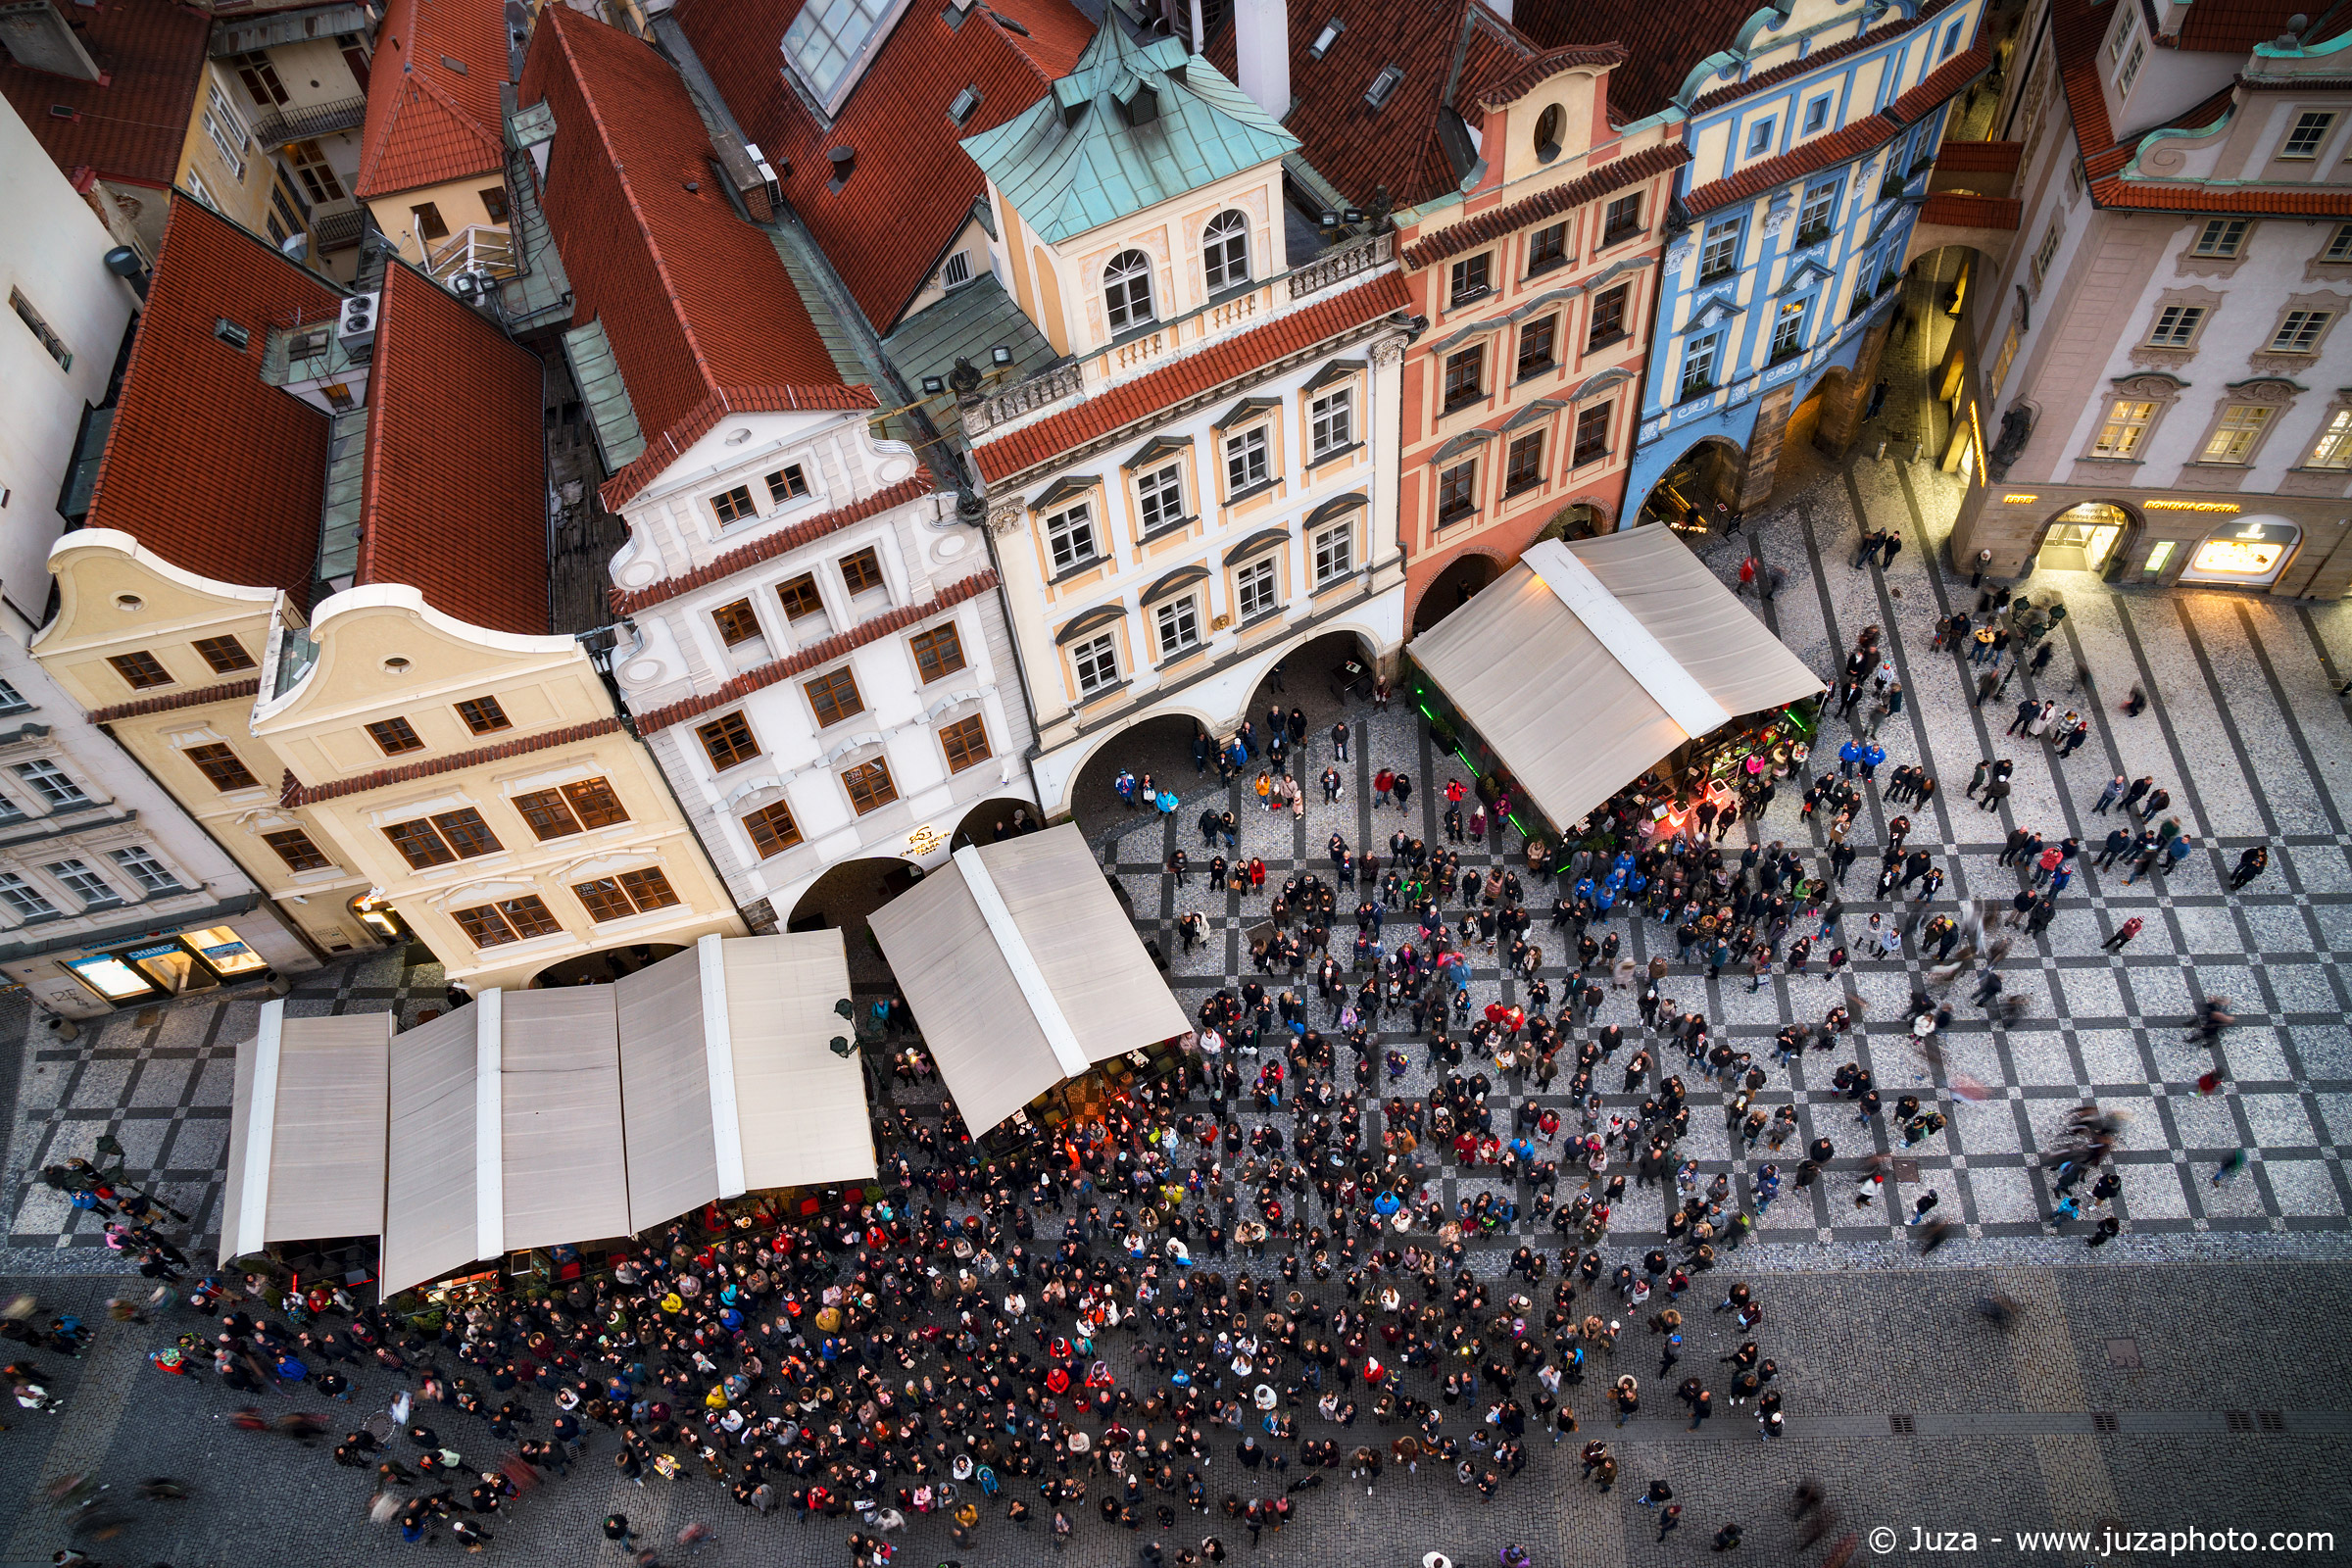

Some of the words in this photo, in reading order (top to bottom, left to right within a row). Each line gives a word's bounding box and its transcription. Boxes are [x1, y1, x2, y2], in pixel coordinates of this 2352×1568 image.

[2144, 500, 2195, 511] BOHEMIA
[2195, 502, 2240, 514] CRYSTAL
[128, 943, 176, 959] CHANGE
